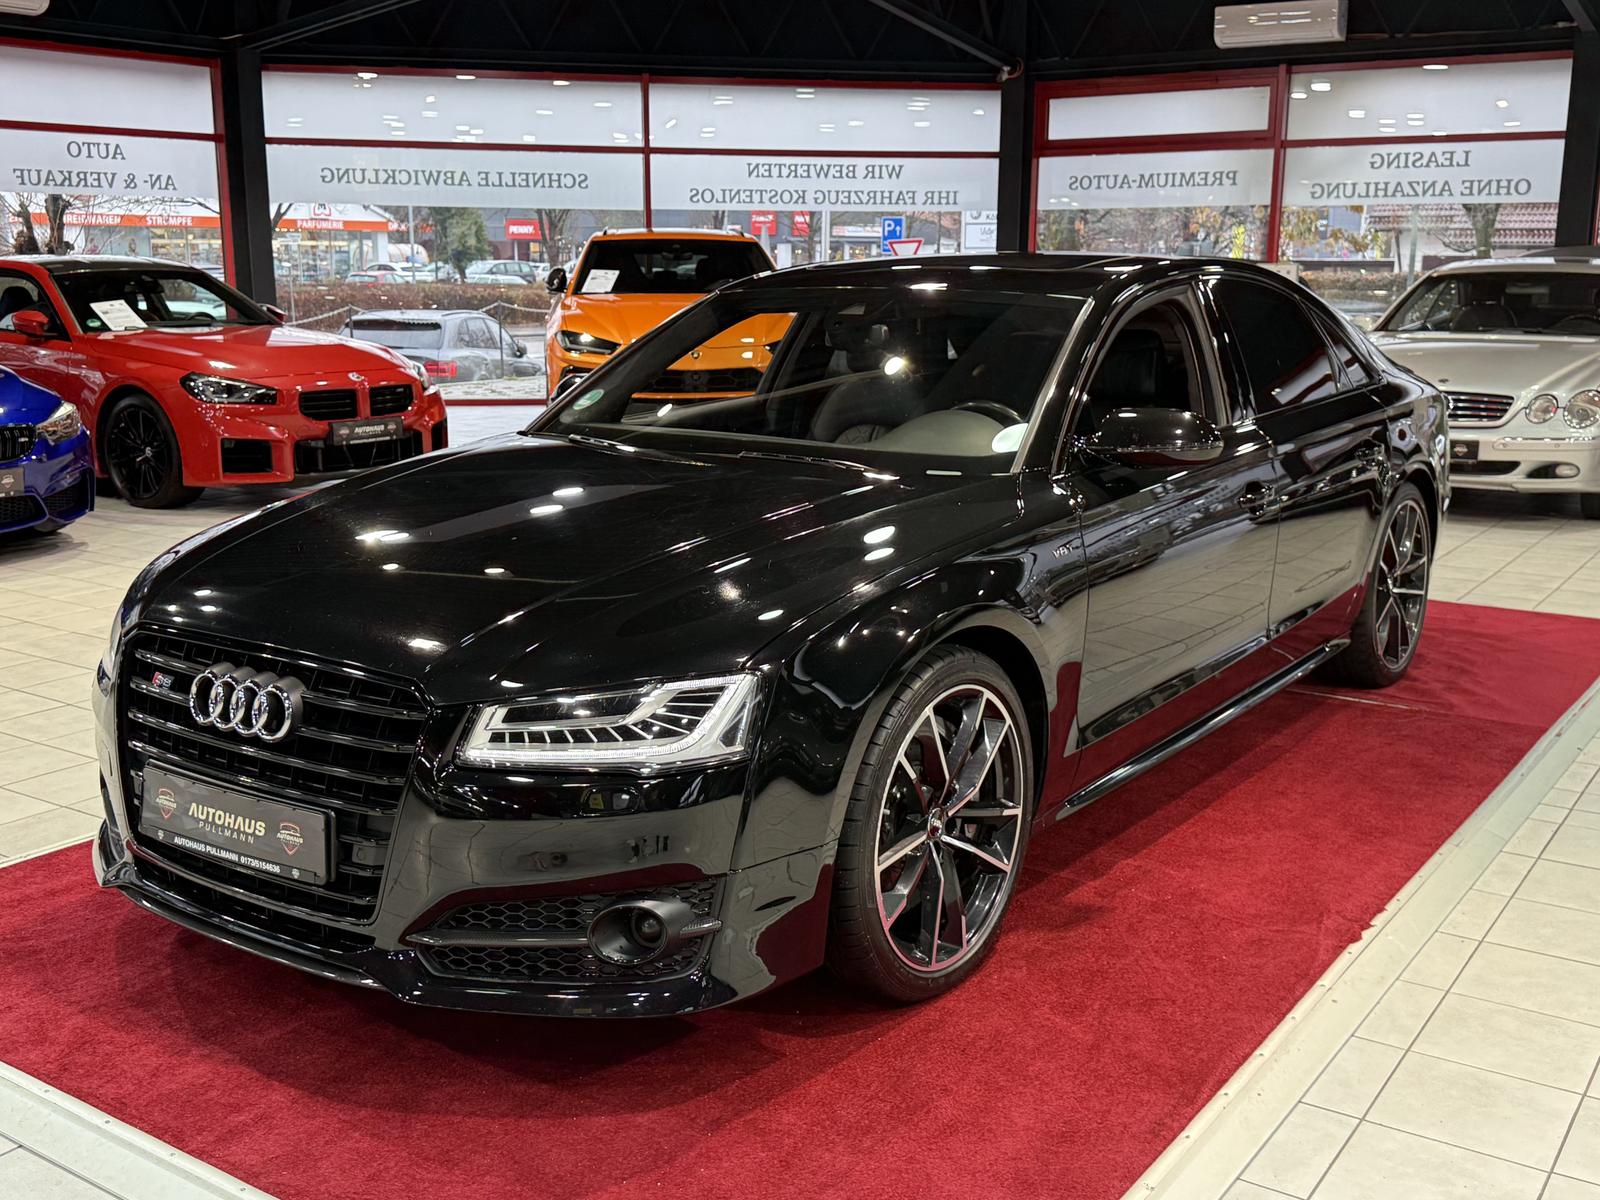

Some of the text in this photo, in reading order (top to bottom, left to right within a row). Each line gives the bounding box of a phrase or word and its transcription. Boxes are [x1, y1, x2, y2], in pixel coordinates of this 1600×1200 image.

[884, 221, 895, 237] P
[188, 802, 266, 837] AUTOHAUS
[199, 821, 255, 844] PULLMANN
[174, 836, 206, 852] AUTOHAUS
[206, 845, 239, 862] PULLMANN
